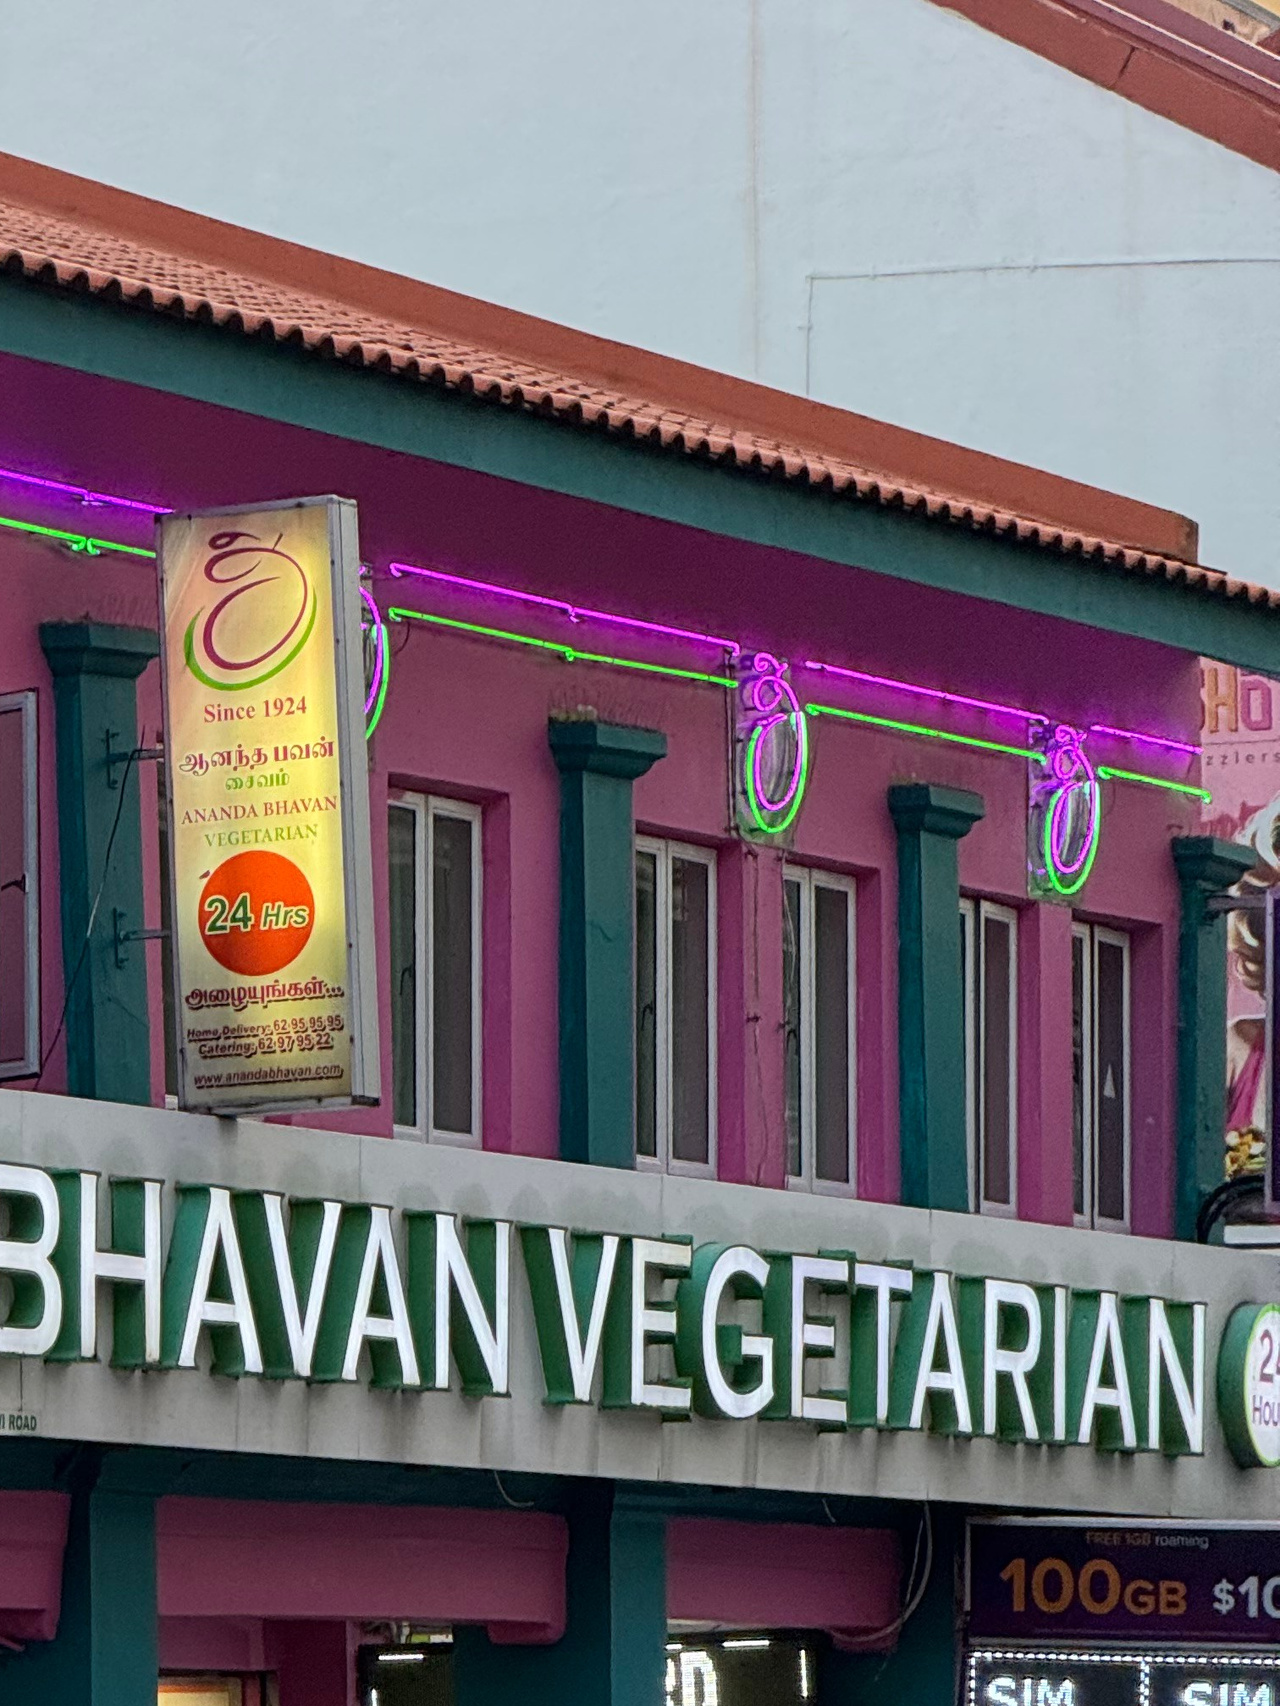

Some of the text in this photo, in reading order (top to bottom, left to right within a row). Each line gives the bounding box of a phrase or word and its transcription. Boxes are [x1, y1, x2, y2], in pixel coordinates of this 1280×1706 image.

[204, 696, 307, 723] Since 1924
[179, 736, 334, 776] ஆனந்த பவன்
[225, 768, 290, 790] சைவம்
[181, 796, 337, 824] ANANDA BHAVAN
[205, 824, 318, 847] VEGETARIAN
[205, 893, 310, 935] 24 Hrs
[273, 1019, 288, 1031] 62
[291, 1017, 306, 1030] 95
[309, 1016, 324, 1028] 95
[327, 1014, 342, 1027] 95
[258, 1037, 273, 1049] 62
[277, 1036, 293, 1048] 97
[316, 1033, 331, 1045] 22
[194, 1064, 342, 1086] www.anandabhavan.com
[518, 1224, 1207, 1457] VEGETARIAN
[1259, 1329, 1280, 1384] 2
[8, 1414, 37, 1431] ROAD
[1155, 1535, 1209, 1549] roaming
[1000, 1557, 1188, 1615] 100GB
